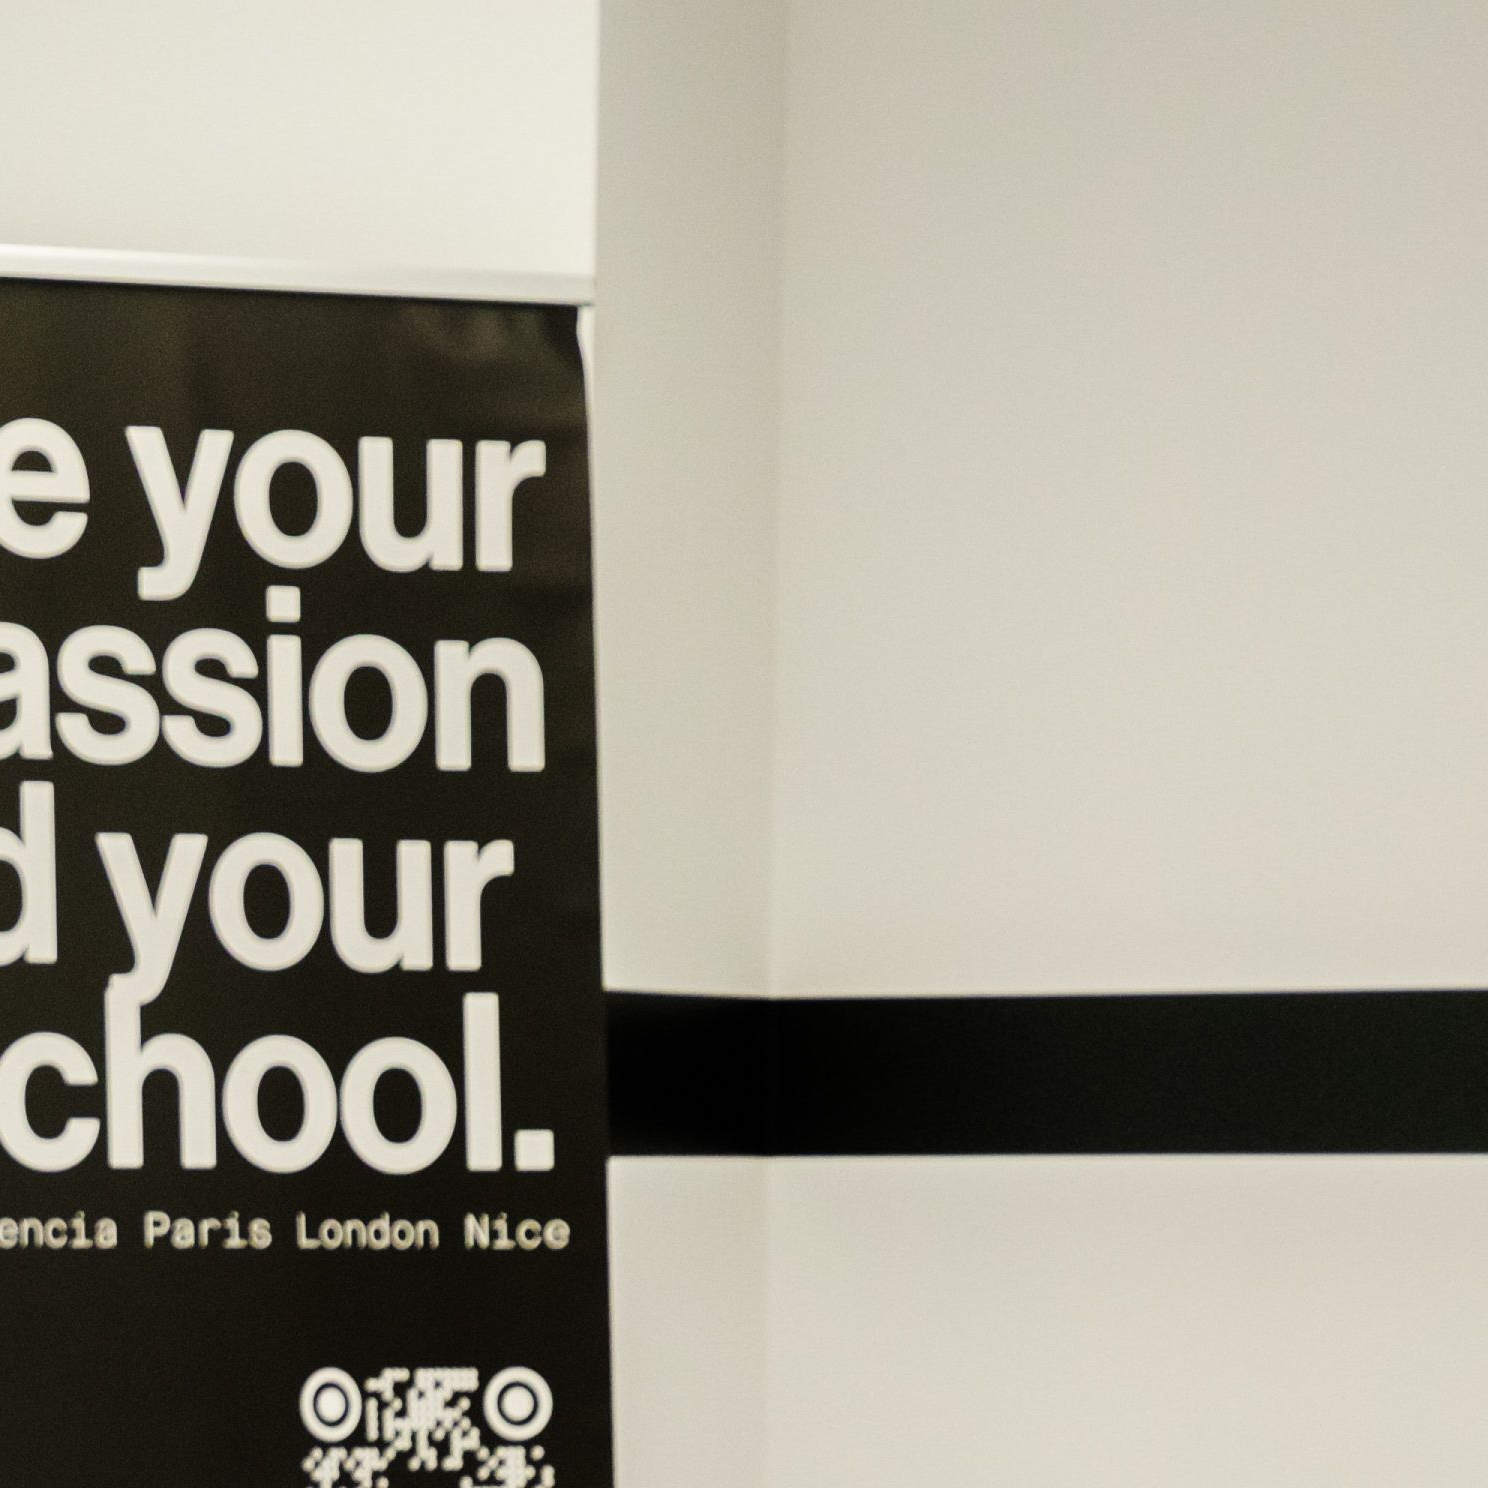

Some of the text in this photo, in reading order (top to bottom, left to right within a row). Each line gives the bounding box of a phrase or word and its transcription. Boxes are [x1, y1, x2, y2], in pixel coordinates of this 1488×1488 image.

[125, 425, 547, 601] your
[95, 832, 515, 1004] your
[144, 1210, 272, 1249] Paris
[296, 1212, 440, 1250] London
[464, 1213, 571, 1250] Nice
